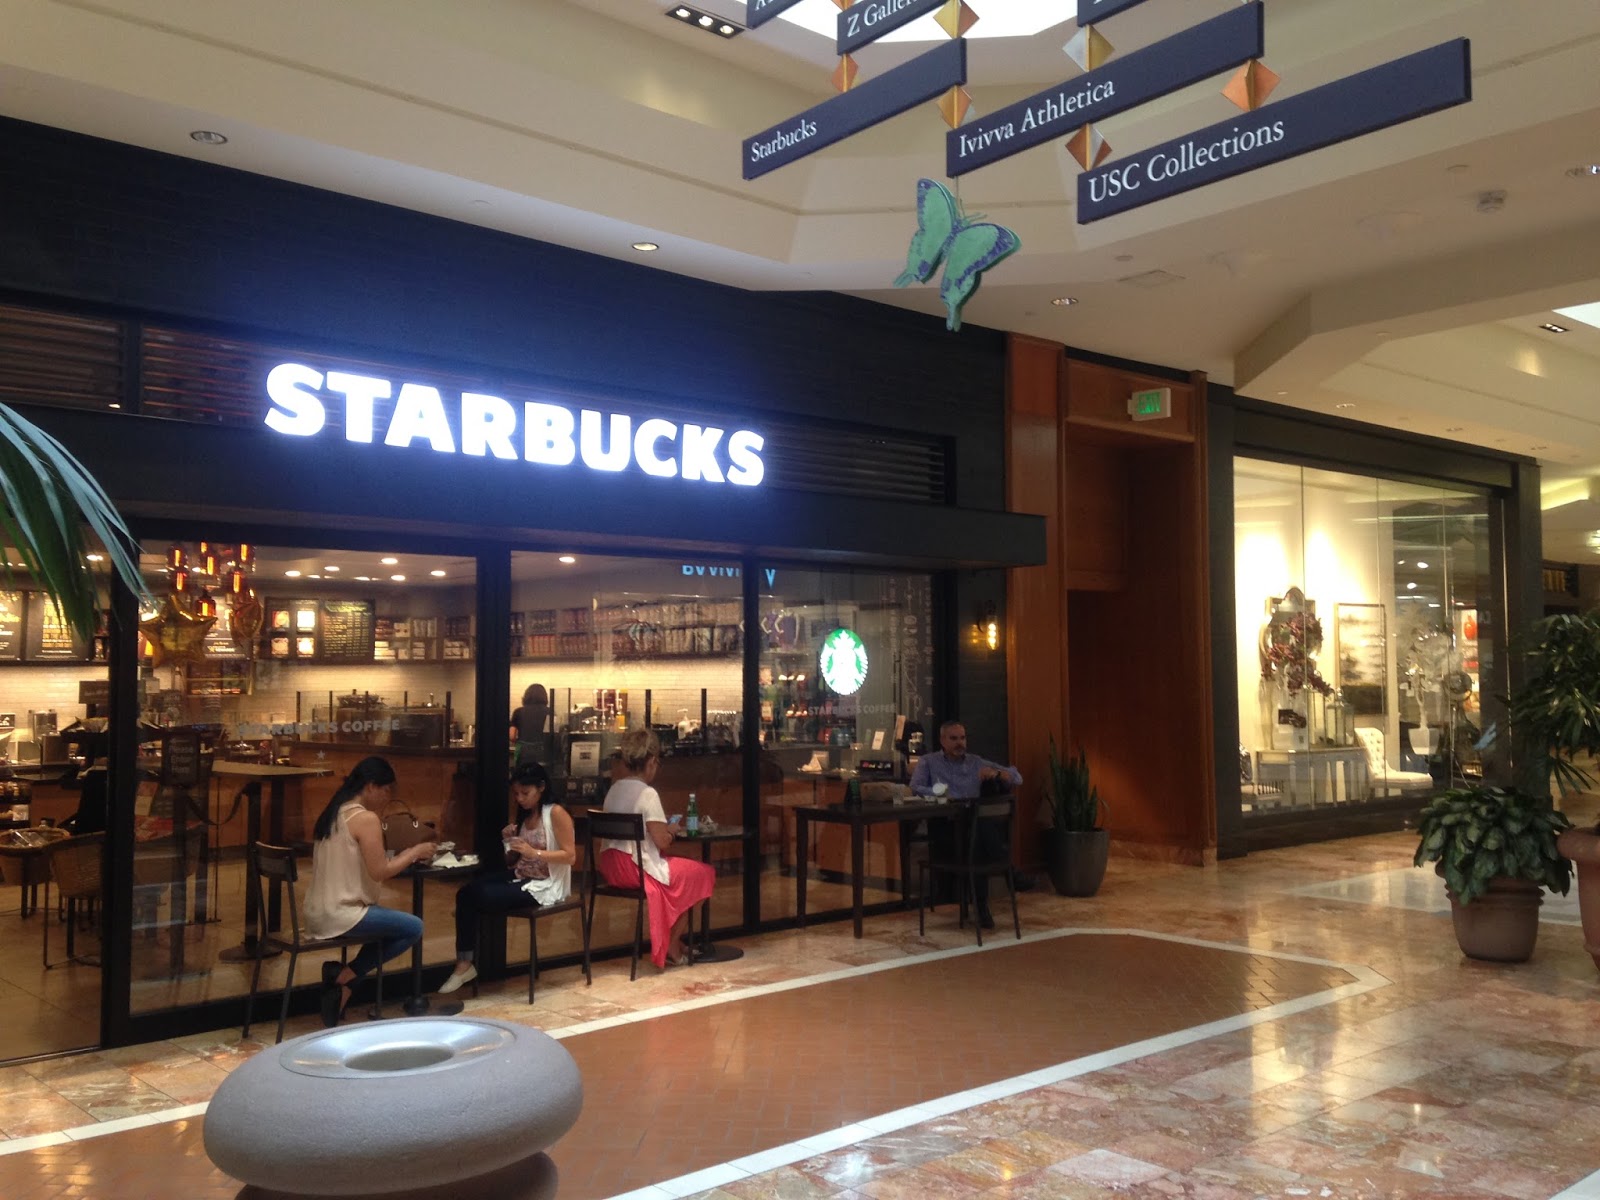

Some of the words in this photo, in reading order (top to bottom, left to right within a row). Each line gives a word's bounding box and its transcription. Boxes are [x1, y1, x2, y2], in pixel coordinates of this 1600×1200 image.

[846, 13, 860, 38] Z
[863, 0, 917, 27] Galle
[750, 119, 818, 163] Starbucks
[958, 124, 1014, 158] Ivivva
[1020, 80, 1116, 134] Athletica
[1088, 163, 1140, 203] USC
[1146, 120, 1285, 182] Collections
[263, 362, 765, 488] STARBUCKS
[342, 719, 401, 733] COFFEE
[808, 704, 862, 716] STARBS
[863, 702, 896, 715] COFFEE
